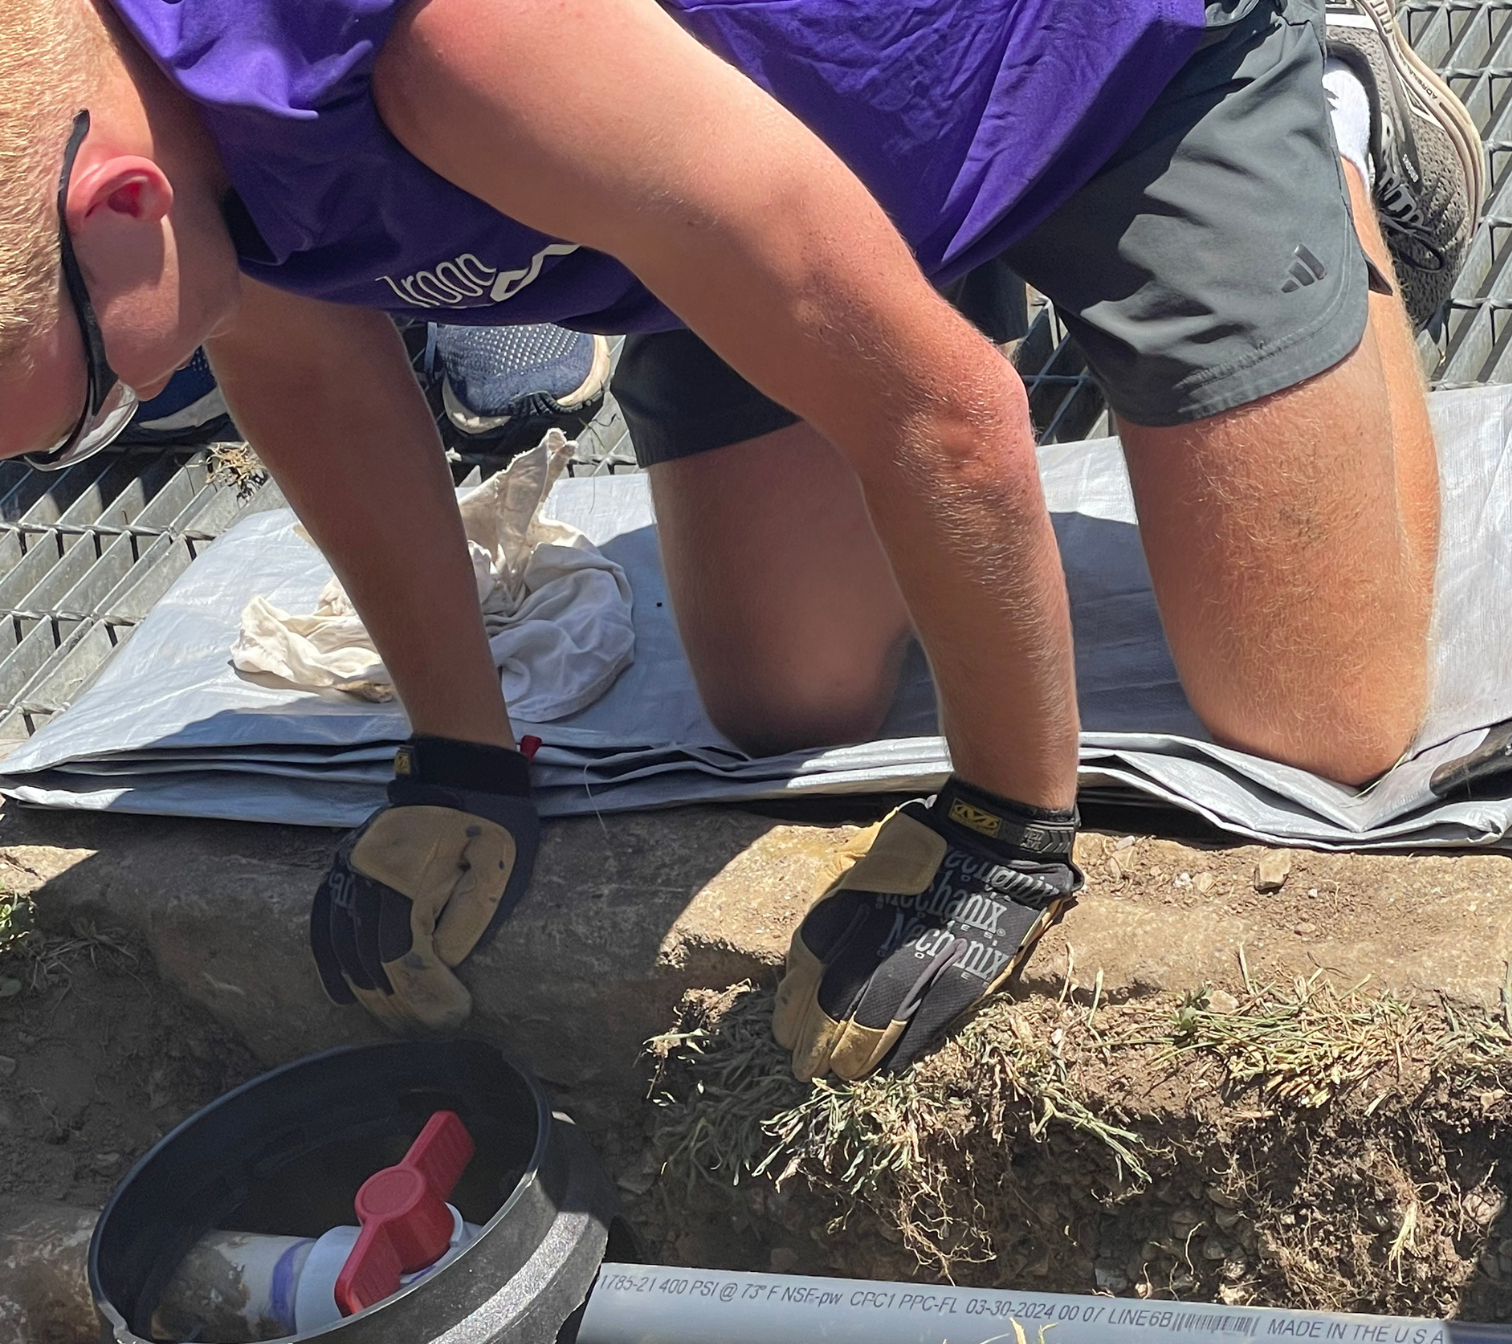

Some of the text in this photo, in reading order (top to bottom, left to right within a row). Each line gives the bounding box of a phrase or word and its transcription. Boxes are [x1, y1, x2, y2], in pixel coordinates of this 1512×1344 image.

[659, 1277, 689, 1295] 400
[689, 1279, 720, 1298] PSI
[719, 1282, 739, 1303] @
[965, 1298, 1055, 1322] 03-30-2024
[1267, 1317, 1325, 1339] MADE
[1325, 1321, 1347, 1340] IN
[1352, 1323, 1392, 1344] THE
